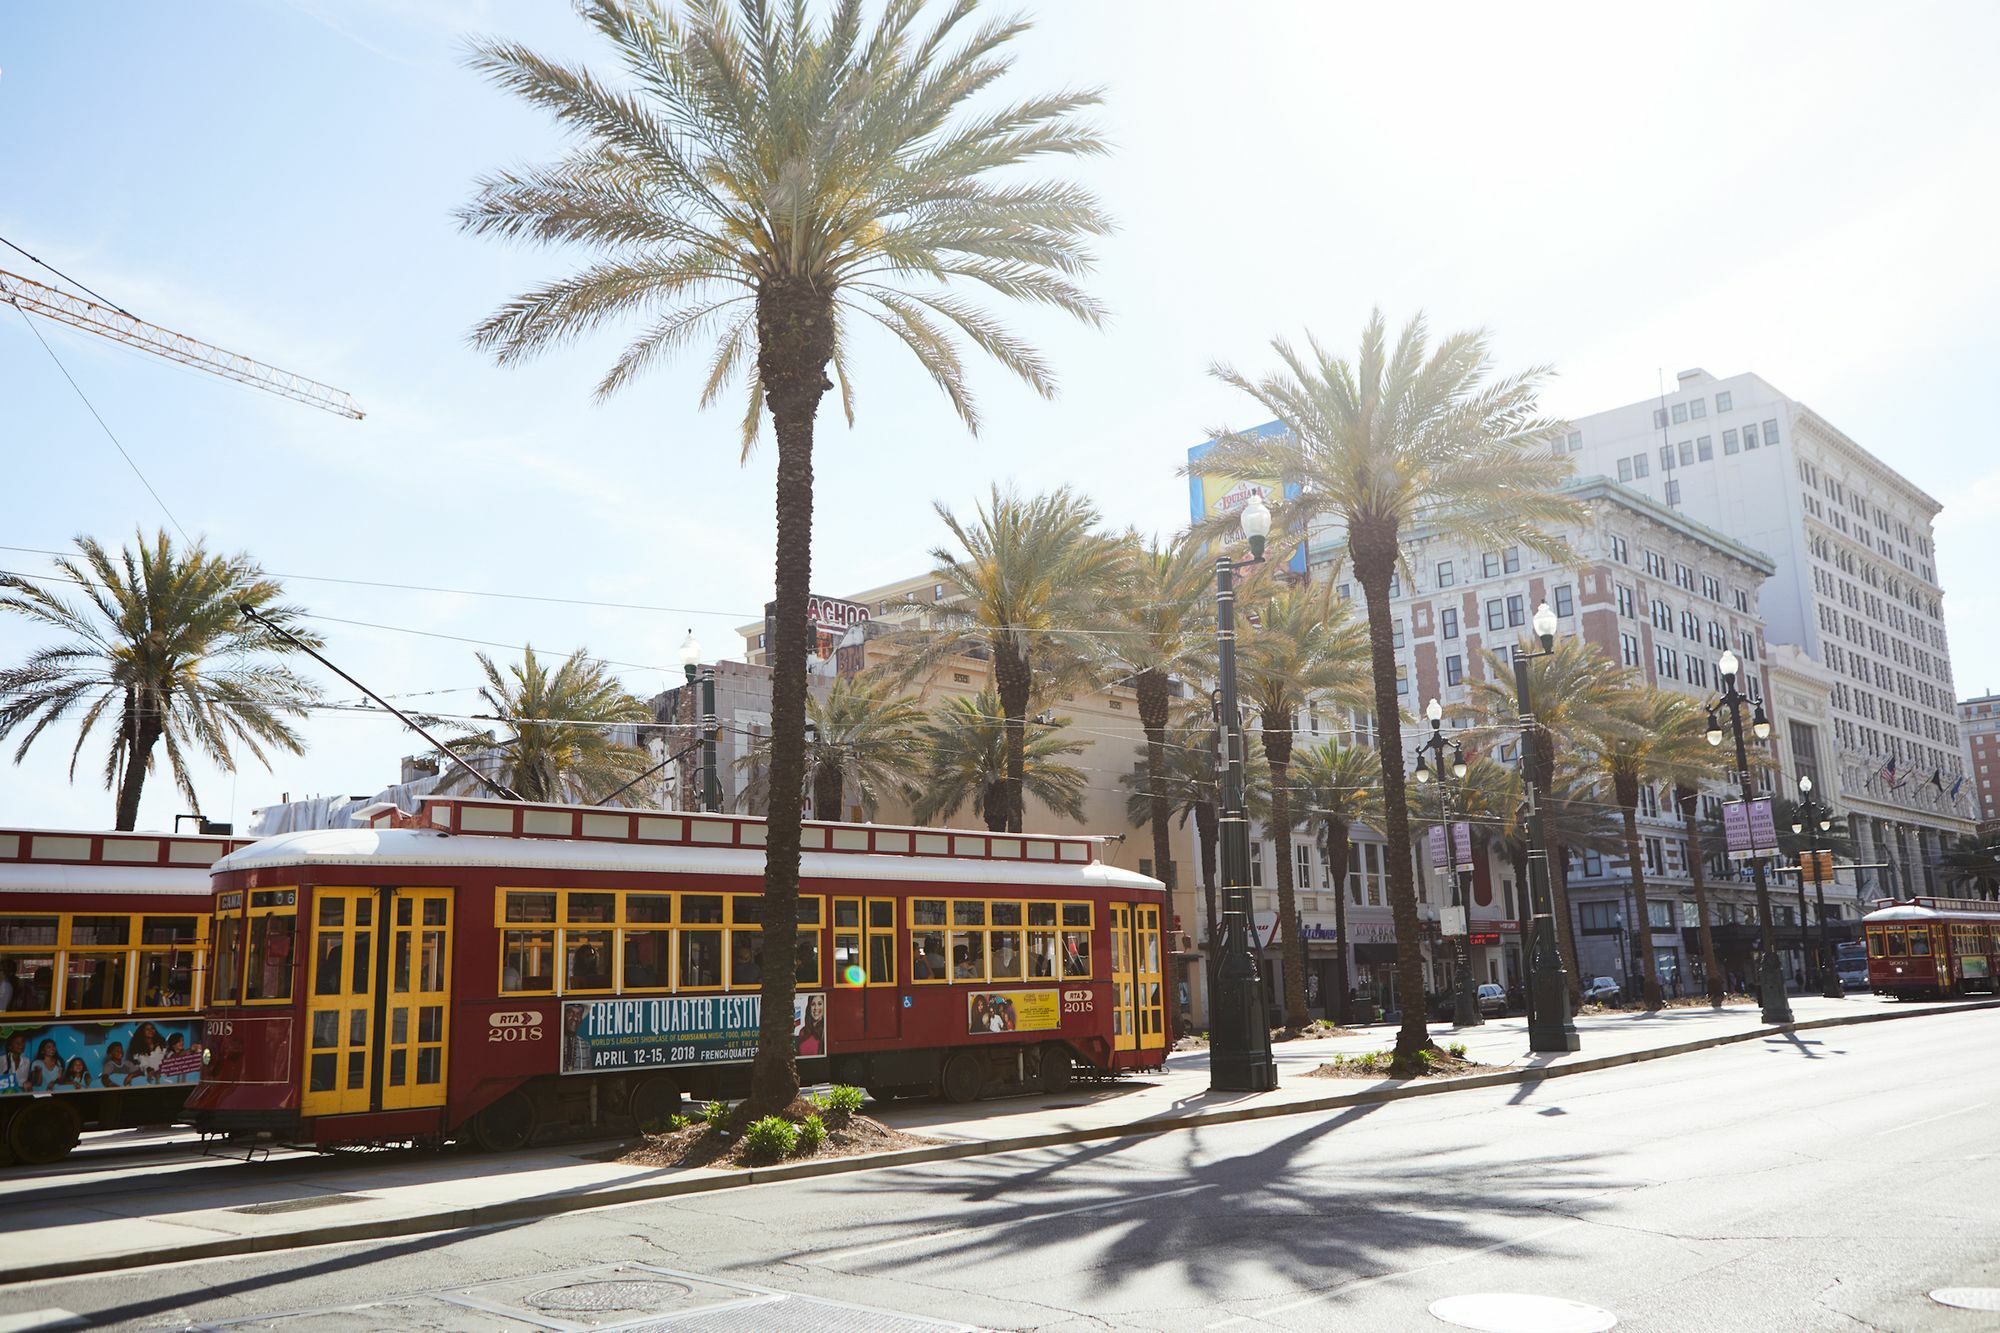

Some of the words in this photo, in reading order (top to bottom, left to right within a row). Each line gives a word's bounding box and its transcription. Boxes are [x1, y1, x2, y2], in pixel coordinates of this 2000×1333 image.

[1221, 486, 1265, 510] LOUISIAA
[807, 597, 871, 626] ACHOO
[221, 894, 241, 909] CANA
[1069, 992, 1081, 1000] RTA
[1064, 1001, 1094, 1013] 2018
[499, 1014, 520, 1025] RTA
[588, 1001, 643, 1036] FRENCH
[651, 998, 713, 1035] QUARTER
[719, 997, 762, 1030] FESTIV
[207, 1021, 233, 1036] 2018
[488, 1026, 543, 1042] 2018
[591, 1037, 615, 1046] WORLD'S
[616, 1036, 640, 1045] LARGEST
[640, 1034, 669, 1044] SHOWCASE
[677, 1032, 707, 1041] LOUISIANA
[751, 1029, 760, 1037] CU
[594, 1050, 628, 1066] APRIL
[633, 1049, 666, 1064] 12-15,
[670, 1046, 695, 1061] 2018
[701, 1047, 760, 1060] FRENCHQUARTE
